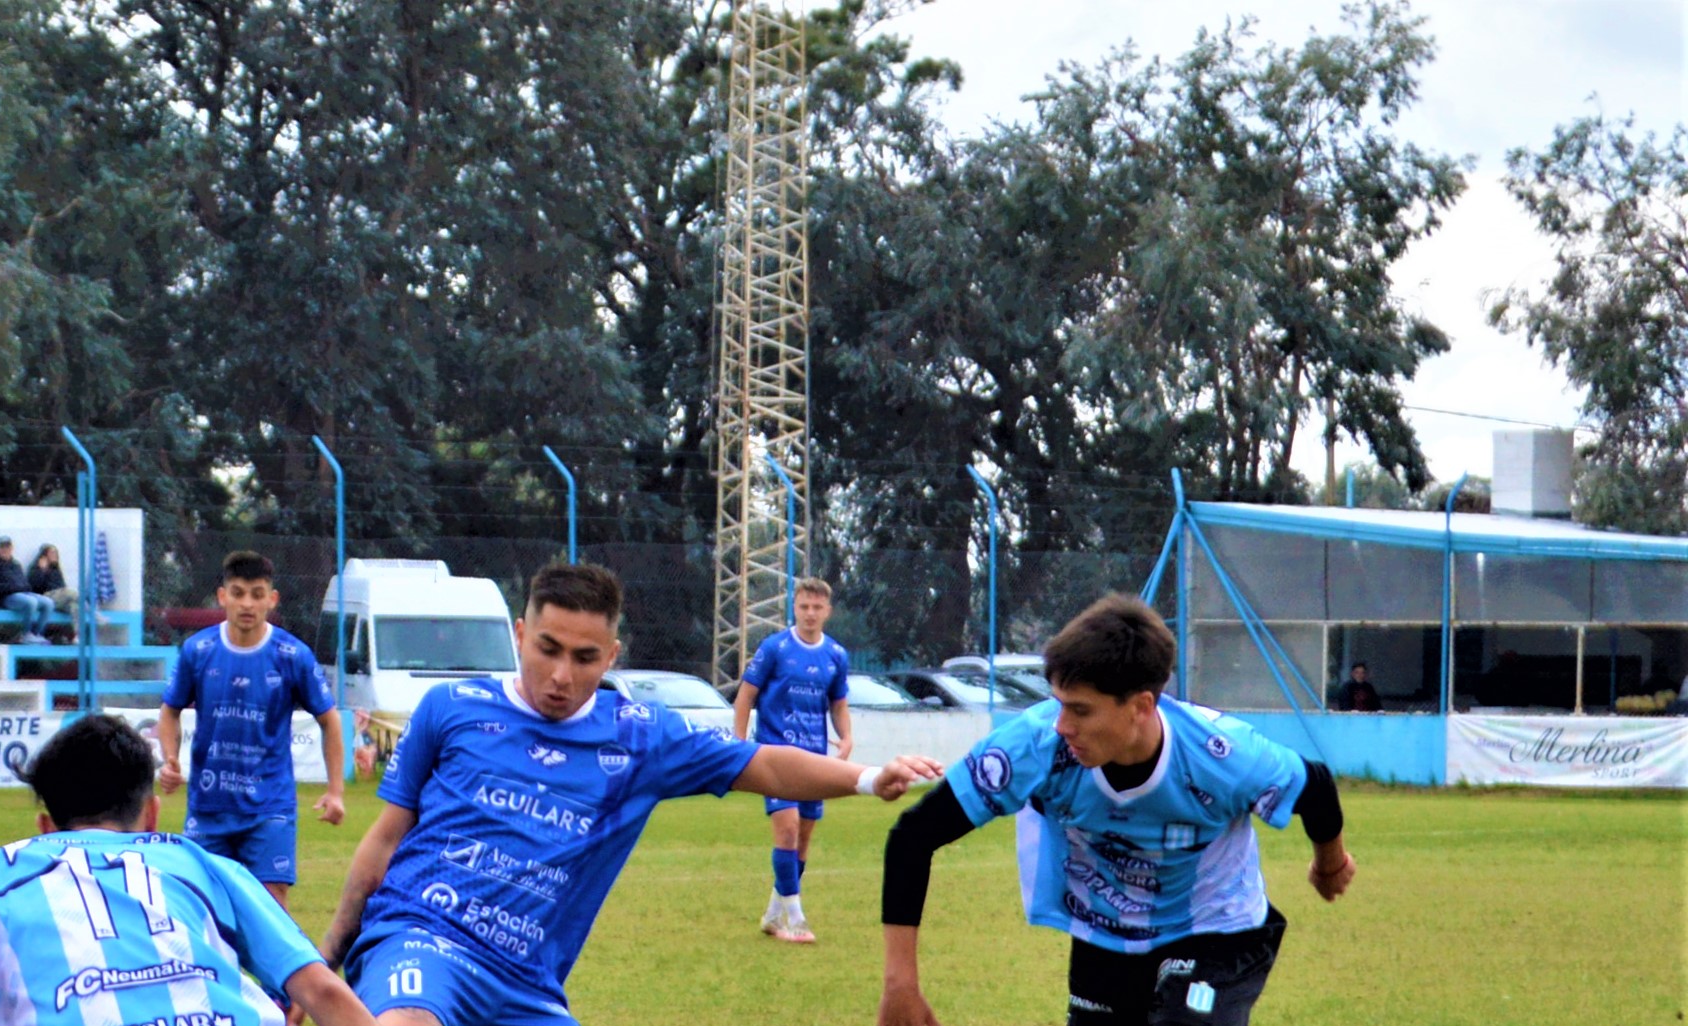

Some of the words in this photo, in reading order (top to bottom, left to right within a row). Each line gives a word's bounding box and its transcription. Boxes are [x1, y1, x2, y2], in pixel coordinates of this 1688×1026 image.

[1508, 727, 1644, 764] Merlina
[1592, 767, 1641, 779] SPORT
[472, 784, 593, 836] AGUILAR'S
[46, 846, 175, 941] 11
[462, 913, 529, 957] Malena
[466, 896, 546, 942] Estación
[55, 966, 102, 1013] FC
[387, 967, 423, 997] 10
